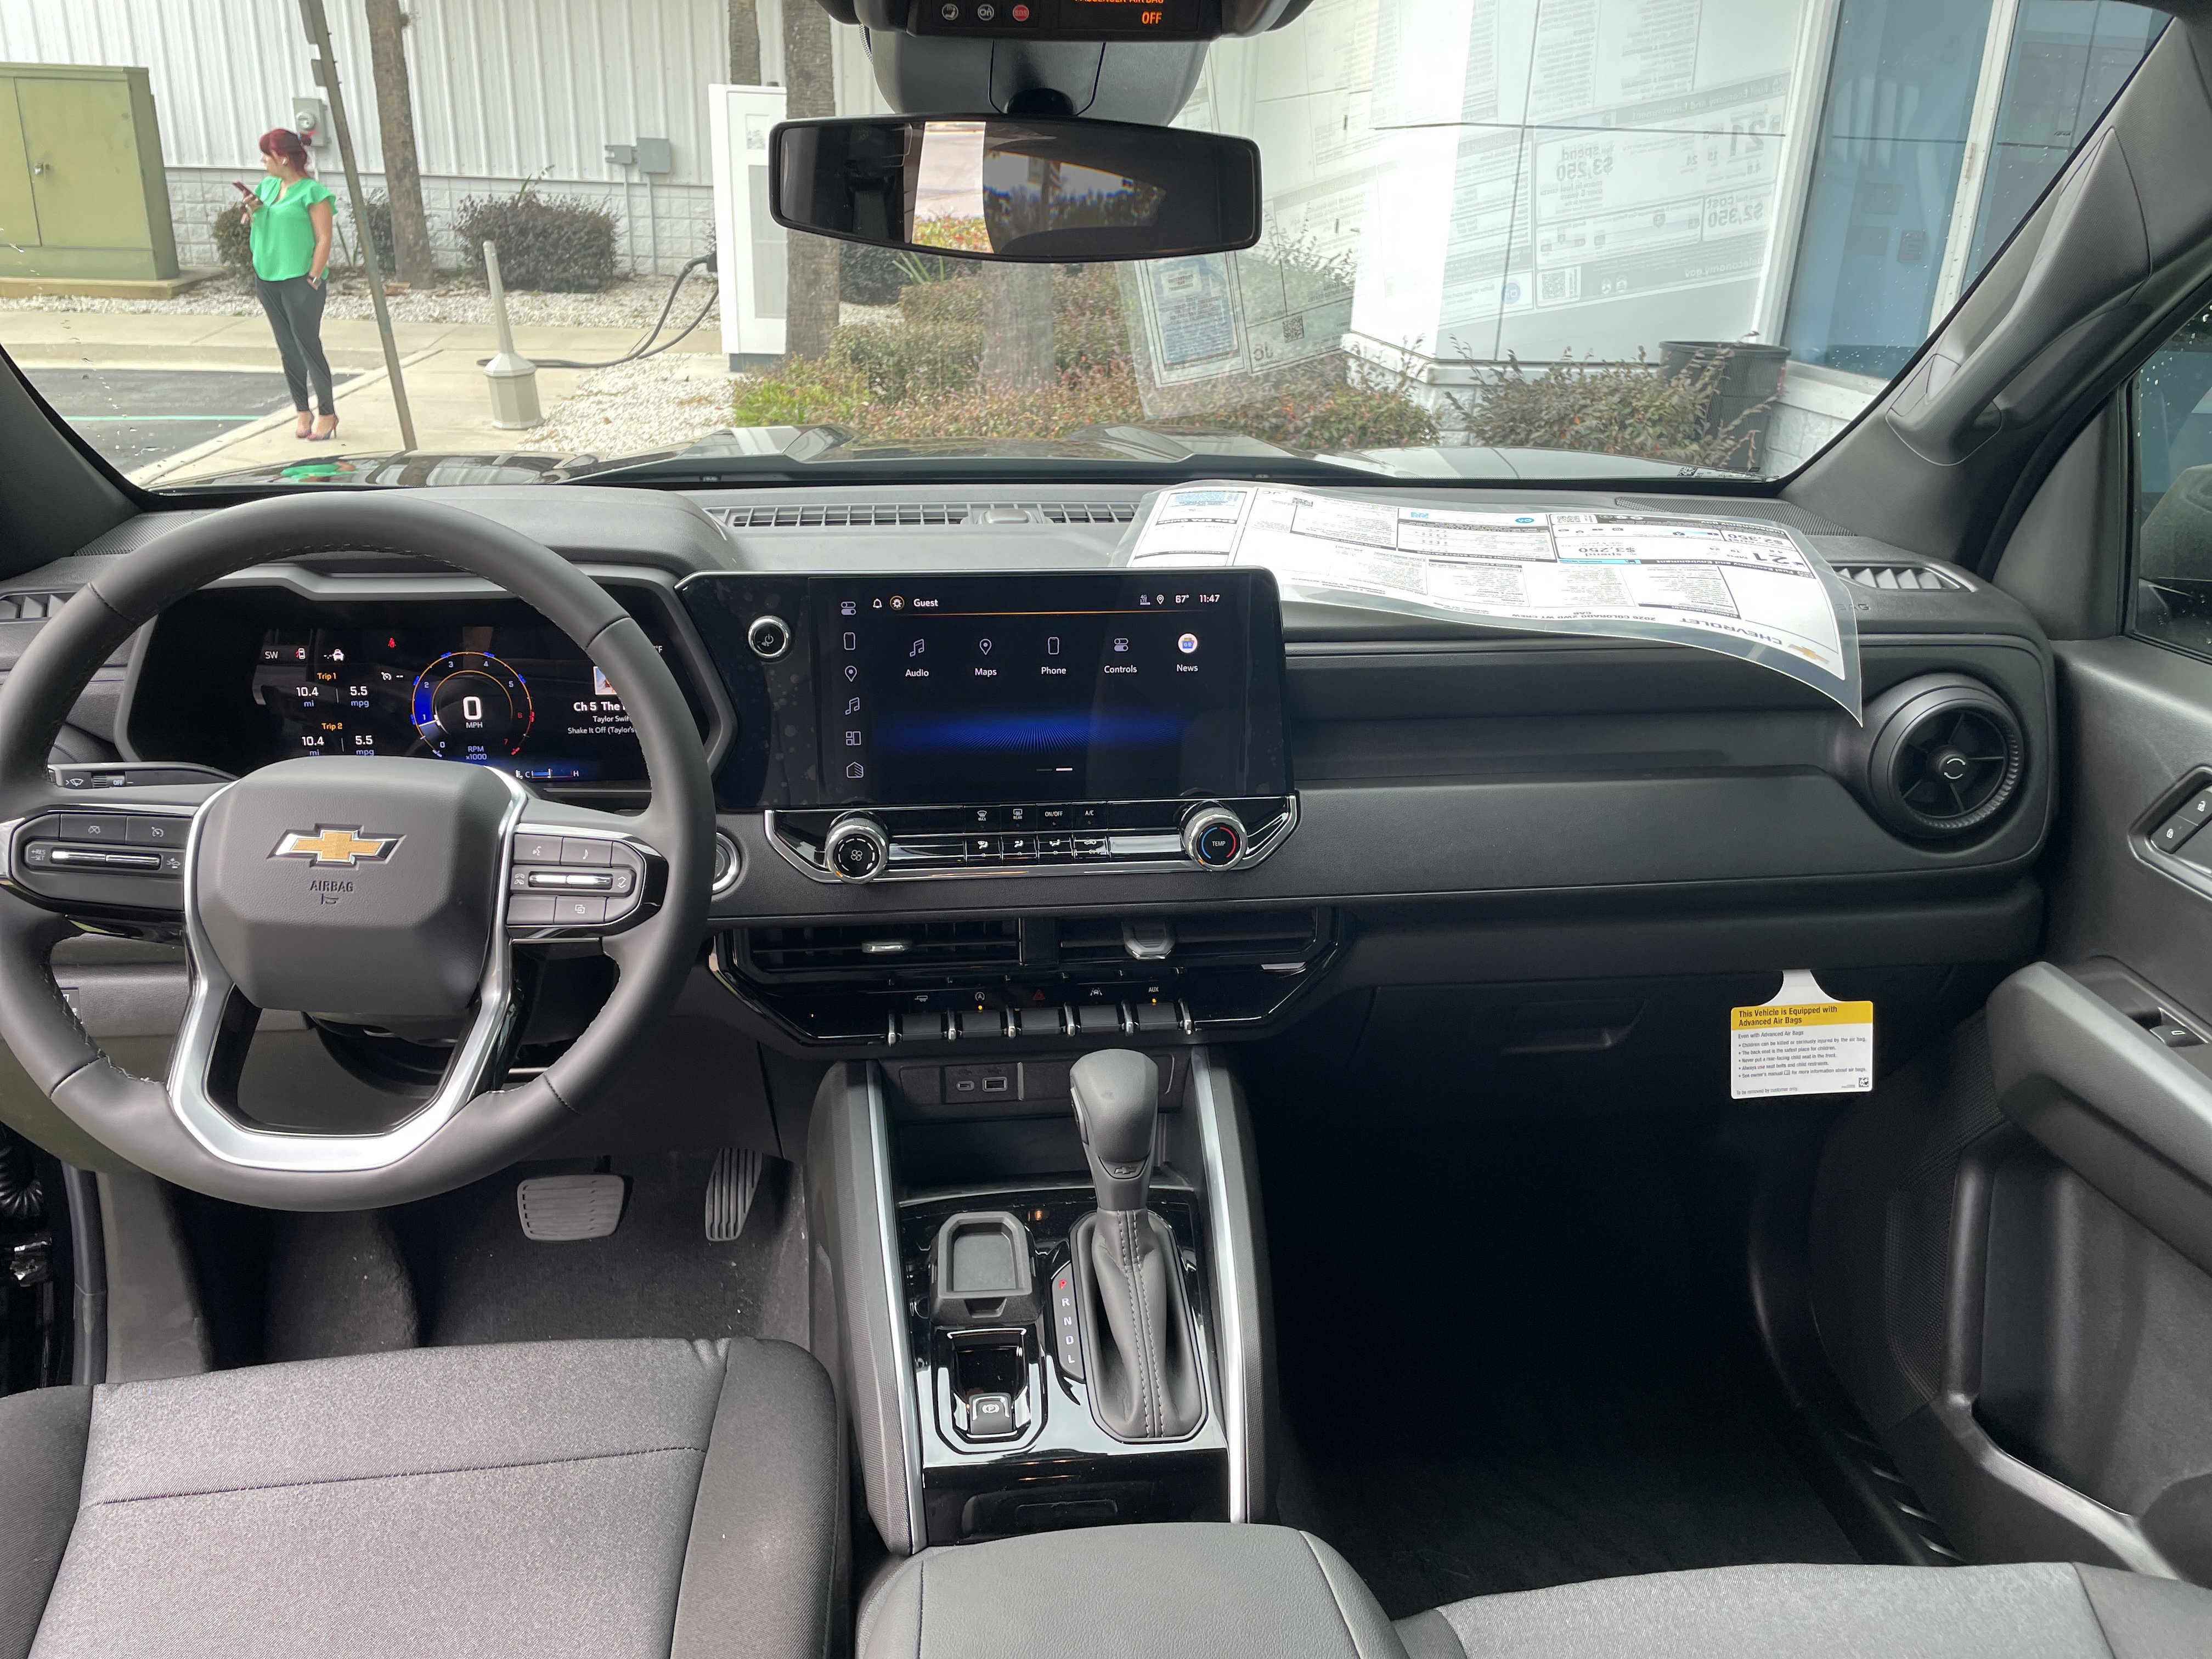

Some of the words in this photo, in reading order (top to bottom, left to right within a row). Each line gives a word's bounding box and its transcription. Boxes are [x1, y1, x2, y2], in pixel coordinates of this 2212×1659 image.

[1141, 11, 1163, 24] OFF
[1753, 552, 1790, 564] 21
[1734, 562, 1773, 571] Economy
[913, 598, 939, 607] Guest
[1175, 594, 1189, 603] 67°
[1199, 594, 1220, 603] 11:47
[1679, 618, 1783, 646] CHEVROLET
[265, 651, 279, 659] SW
[905, 668, 929, 677] Audio
[975, 668, 997, 677] Maps
[1041, 666, 1066, 675] Phone
[1104, 664, 1137, 674] Controls
[1176, 664, 1198, 672] News
[317, 672, 332, 681] Trip
[296, 686, 319, 697] 10.4
[349, 686, 368, 696] 5.5
[463, 696, 482, 720] 0
[573, 701, 588, 712] Ch
[590, 702, 597, 711] 5
[601, 701, 620, 711] The
[592, 715, 614, 724] Taylor
[321, 723, 336, 731] Trip
[607, 726, 635, 735] (Taylor's
[301, 736, 324, 746] 10.4
[355, 735, 373, 745] 5.5
[310, 881, 353, 892] AIRBAG
[1789, 1007, 1820, 1015] Equipped
[1739, 1018, 1771, 1026] Advanced
[1059, 1279, 1067, 1290] P
[1062, 1298, 1070, 1307] R
[1063, 1316, 1072, 1325] N
[1065, 1335, 1074, 1345] D
[1068, 1355, 1075, 1363] L
